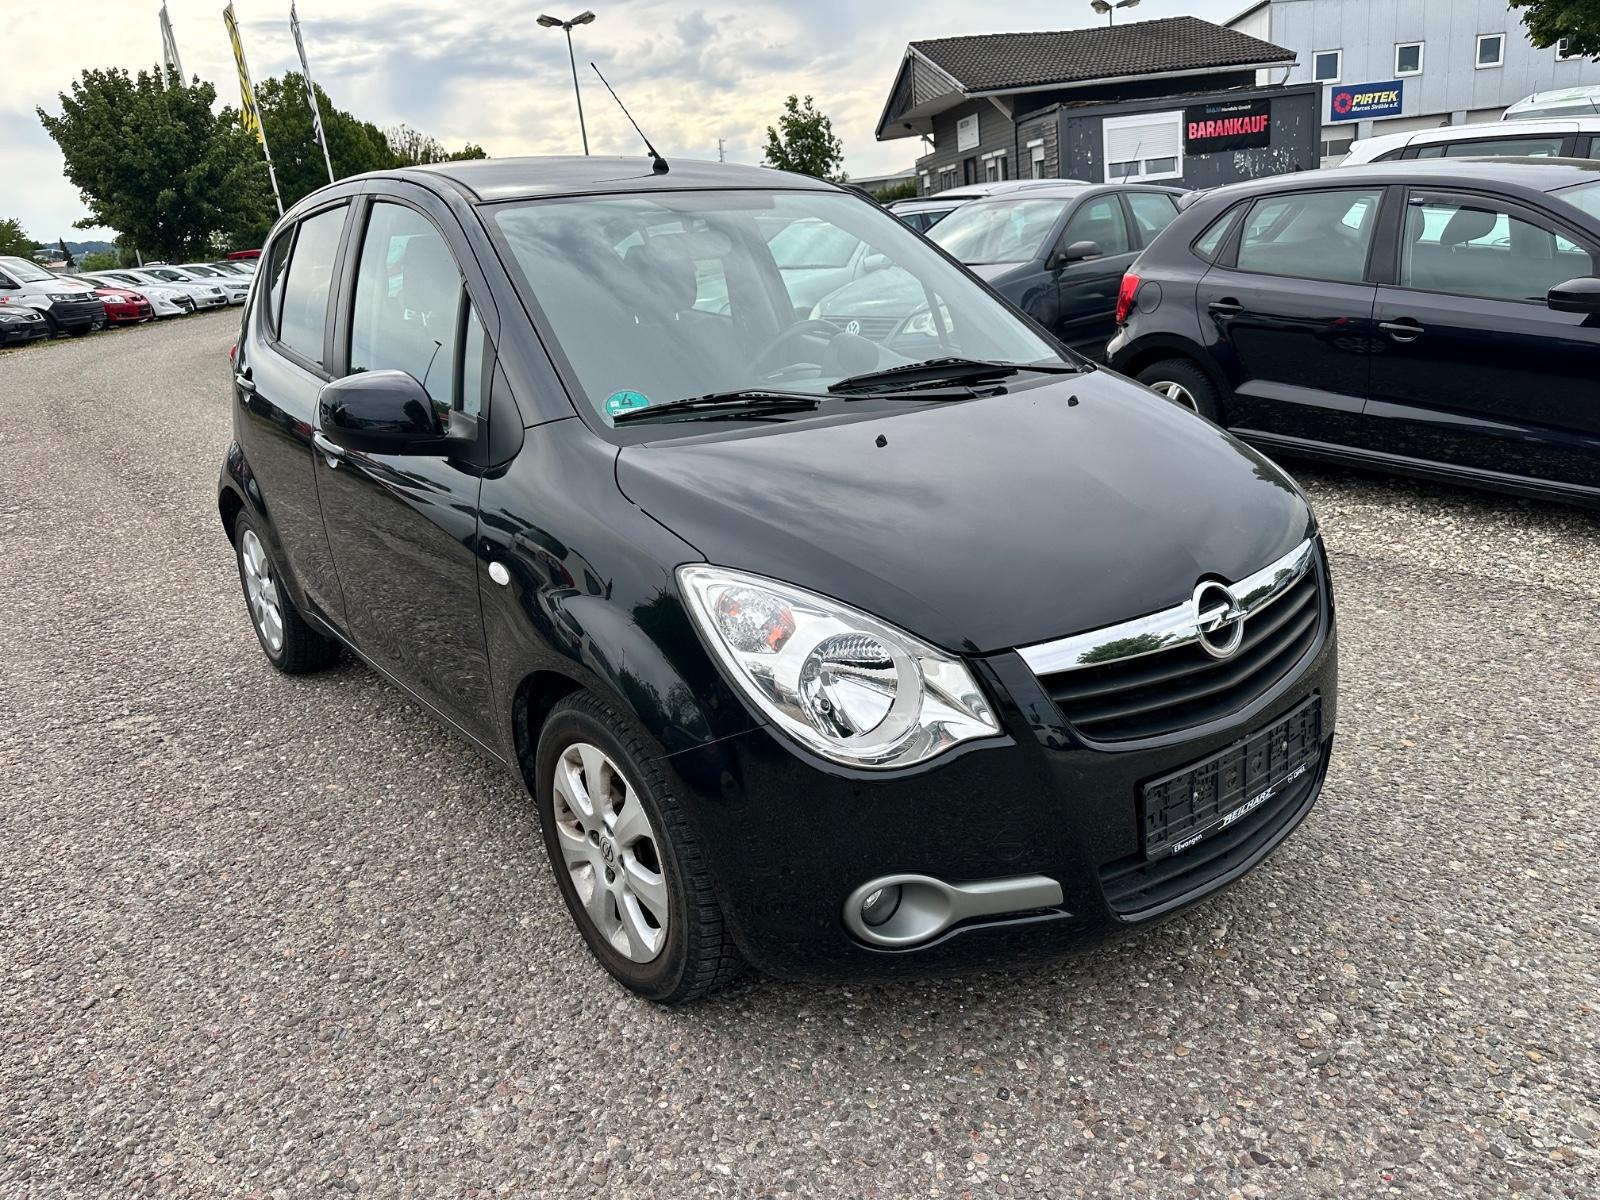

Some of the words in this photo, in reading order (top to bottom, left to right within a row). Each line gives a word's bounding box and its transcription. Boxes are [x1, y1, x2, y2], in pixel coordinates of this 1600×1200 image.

[1352, 90, 1399, 106] PIRTEK
[1188, 115, 1268, 140] BARANKAUF
[621, 393, 633, 407] 4
[1174, 833, 1203, 853] Ellwangen
